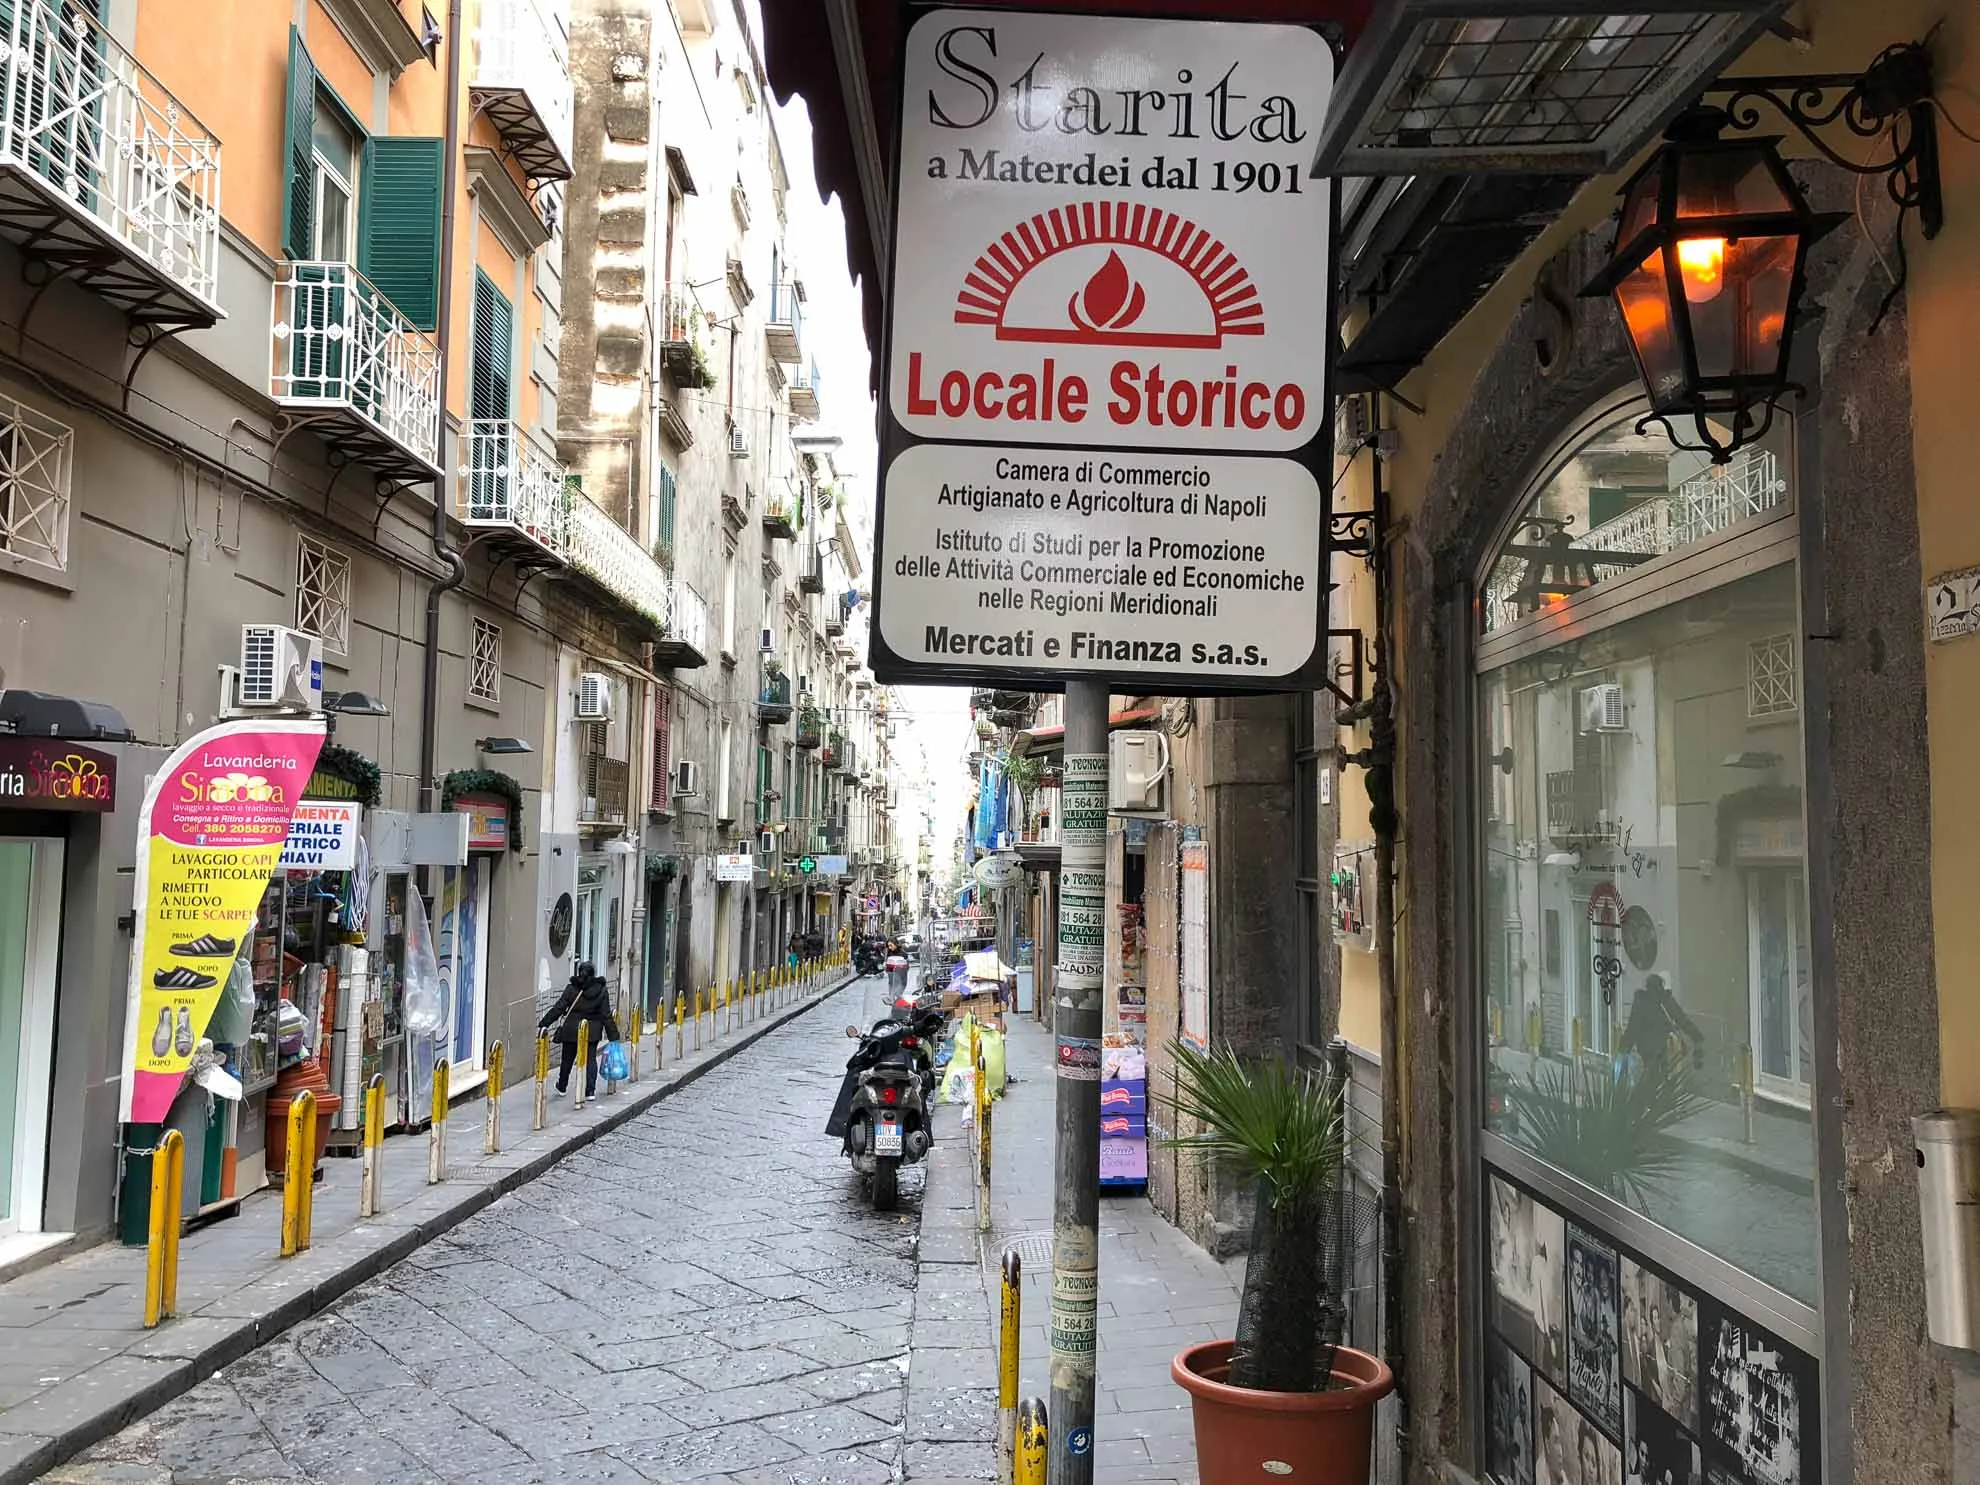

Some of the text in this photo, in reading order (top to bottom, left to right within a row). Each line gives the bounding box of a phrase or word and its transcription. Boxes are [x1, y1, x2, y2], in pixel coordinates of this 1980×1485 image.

[928, 27, 1306, 144] Starita
[927, 148, 1303, 194] a Materdei dal 1901
[907, 352, 1306, 431] Locale Storico
[996, 458, 1210, 487] Camera di Commercio
[937, 484, 1267, 521] Artigianato e Agricoltura di Napoli
[936, 528, 1265, 562] Istituto di Studi per la Promozione
[895, 555, 1305, 592] delle Attività Commerciale ed Economiche
[978, 588, 1218, 618] nelle Regioni Meridionali
[924, 625, 1268, 666] Mercati e Finanza s.a.s.
[203, 752, 297, 769] Lavanderia
[245, 804, 289, 813] tradizionale
[1074, 797, 1091, 809] 564
[173, 815, 212, 824] Consegna
[221, 815, 243, 823] Ritiro
[253, 815, 290, 824] Domicilio
[204, 824, 226, 833] 380
[230, 824, 282, 834] 2058270
[172, 853, 272, 865] LAVAGGIO CAPI
[279, 852, 323, 864] HIAVI
[187, 868, 272, 880] PARTICOLARI
[162, 882, 209, 893] RIMETTI
[160, 896, 222, 907] A NUOVO
[160, 909, 172, 920] LE
[176, 909, 199, 920] TUE
[1073, 913, 1090, 924] 564
[197, 964, 218, 972] DOPO
[174, 997, 195, 1005] PRIMA
[148, 1059, 171, 1067] DOPO
[1064, 1318, 1081, 1330] 564
